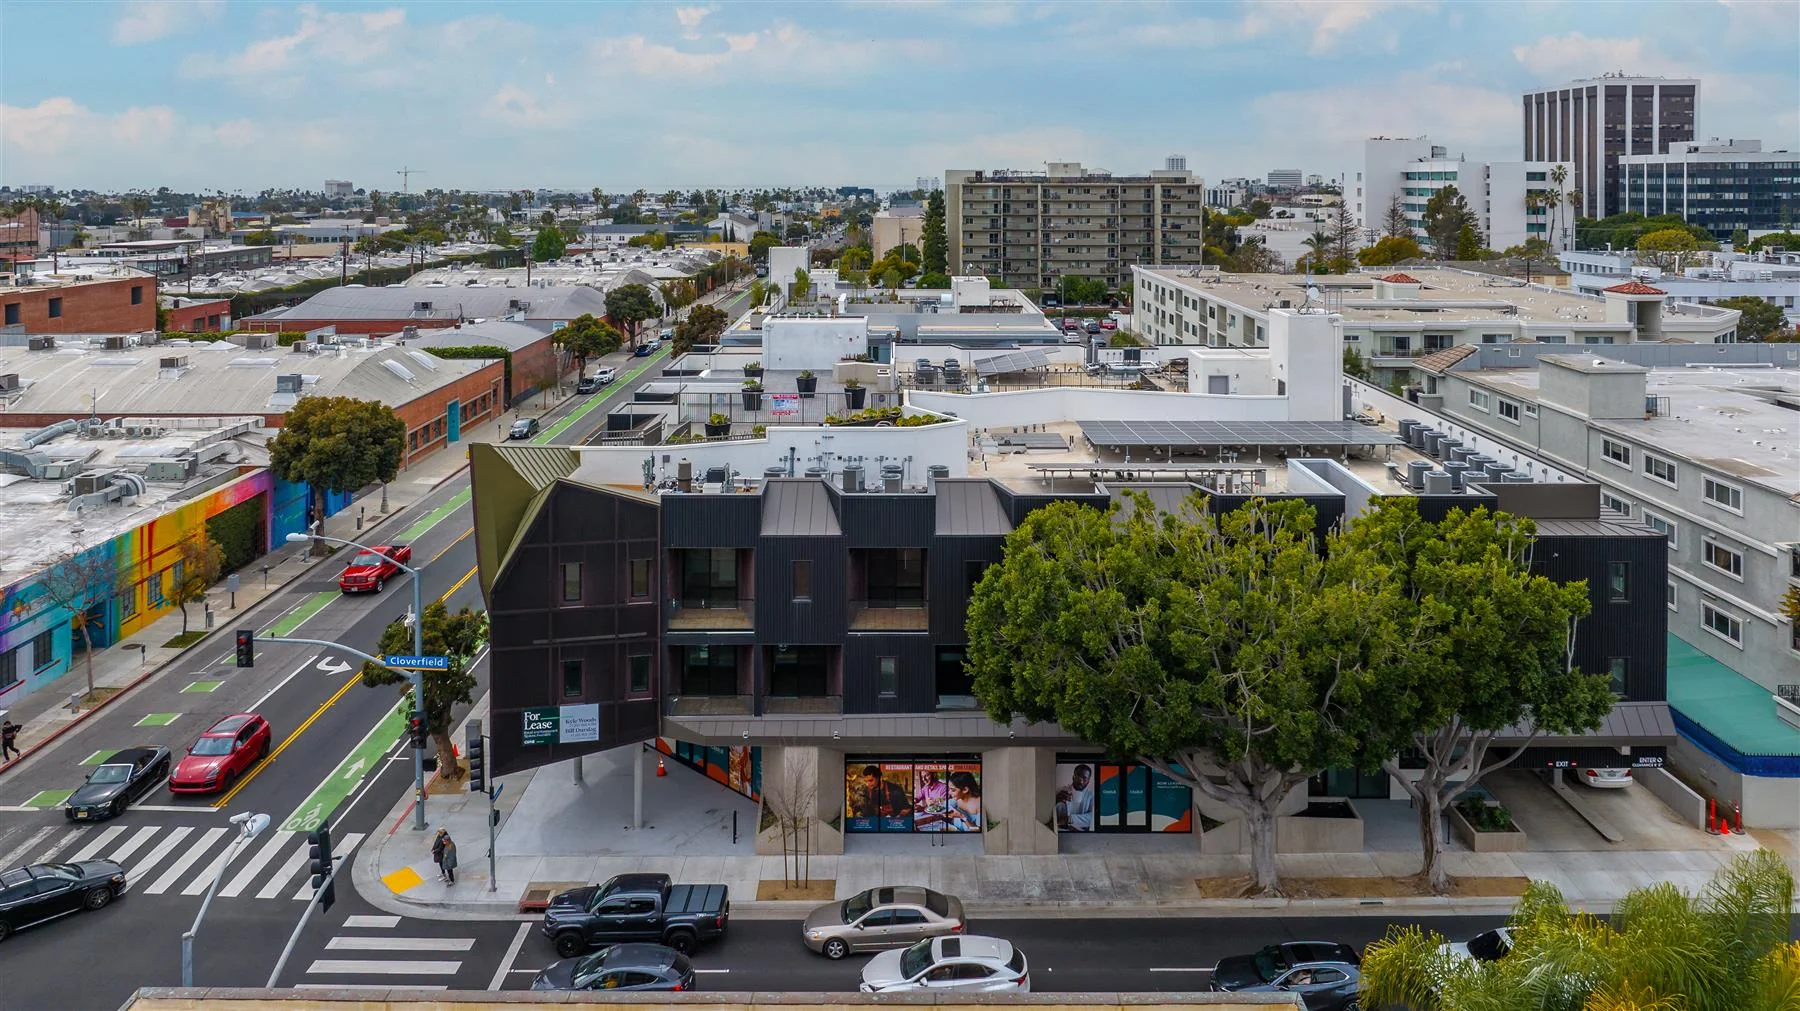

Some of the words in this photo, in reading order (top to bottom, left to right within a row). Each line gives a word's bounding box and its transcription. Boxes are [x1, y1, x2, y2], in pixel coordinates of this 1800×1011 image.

[390, 656, 443, 666] Cloverfield
[524, 711, 541, 721] For
[524, 720, 553, 730] Lease
